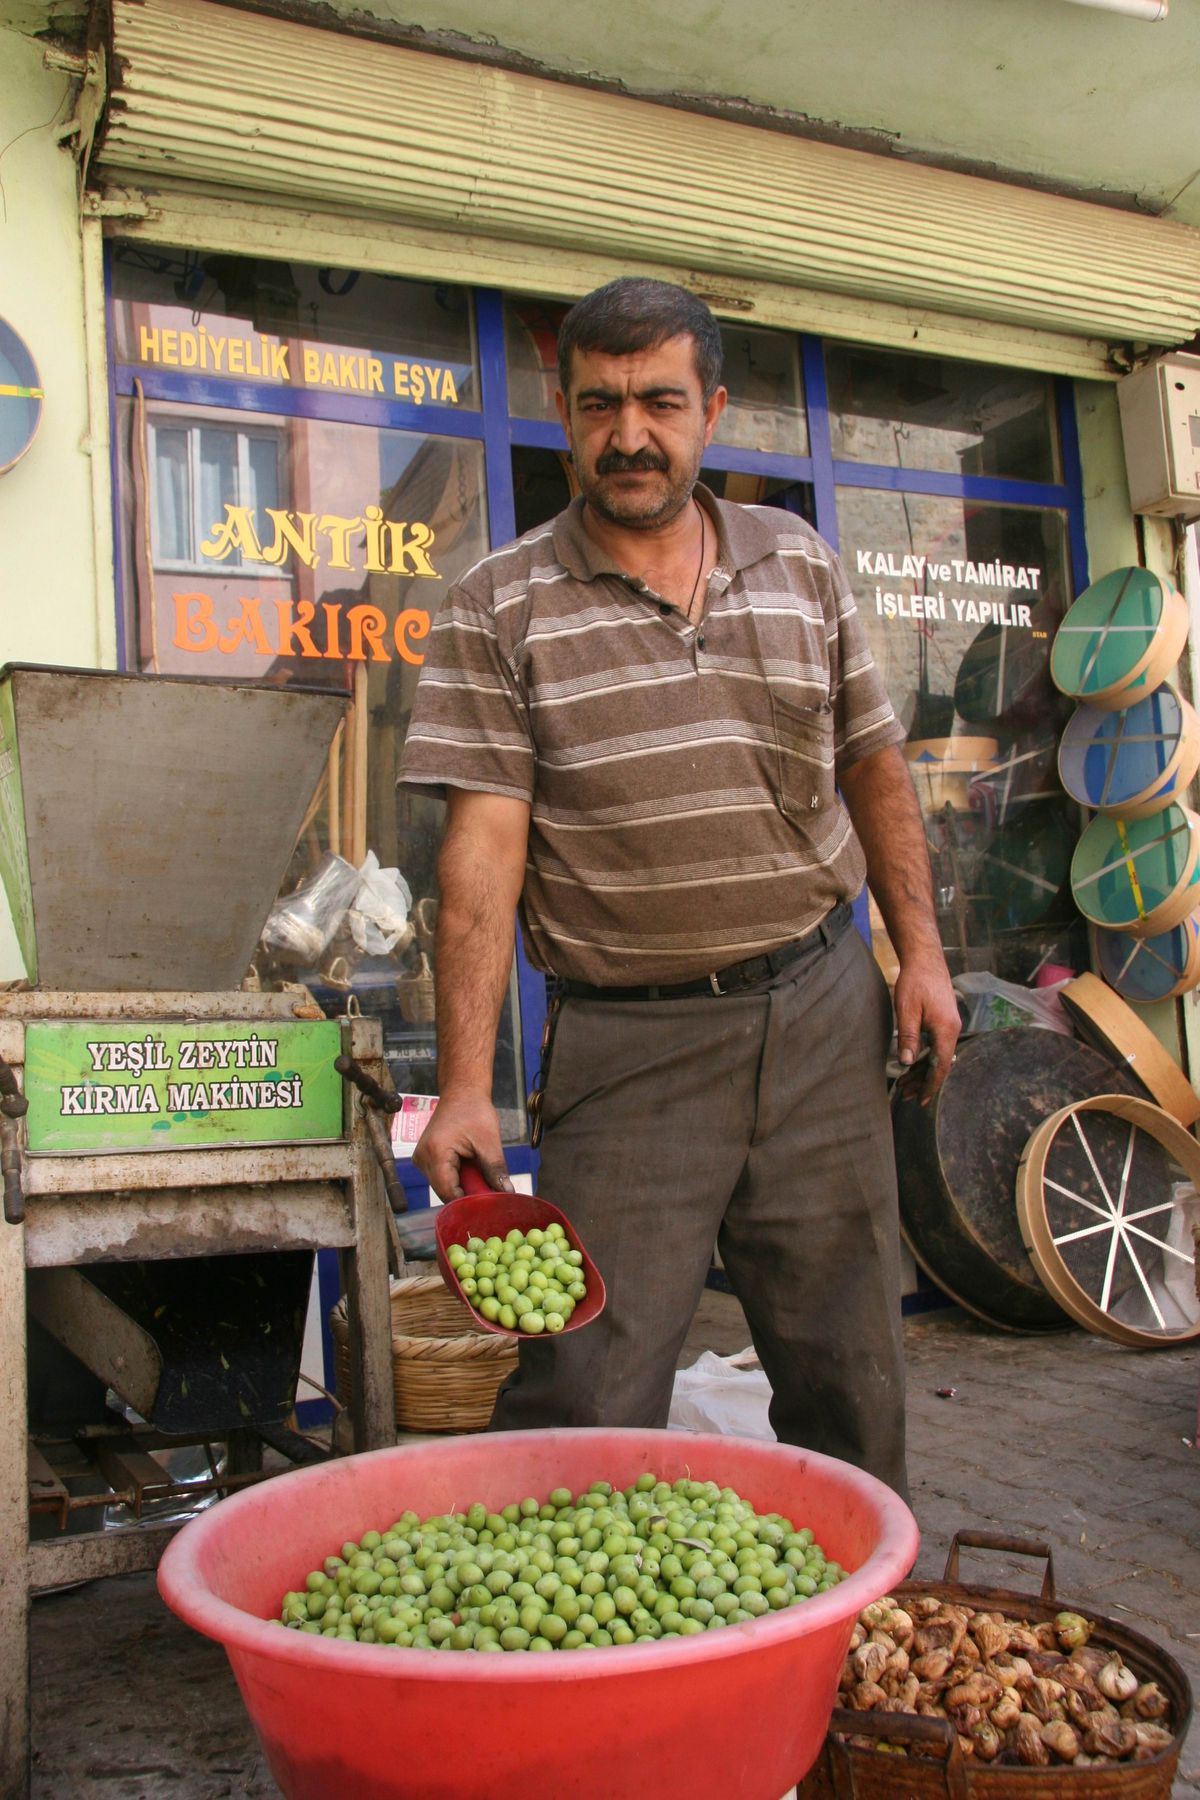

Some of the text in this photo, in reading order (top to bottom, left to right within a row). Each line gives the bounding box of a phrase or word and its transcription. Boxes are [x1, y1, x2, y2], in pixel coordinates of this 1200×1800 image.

[139, 325, 458, 405] HEDİYELİK BAKIR EŞYA
[200, 503, 442, 579] ANTİK
[857, 550, 1040, 590] KALAY ve TAMİRAT
[172, 592, 430, 665] BAKIRC
[876, 586, 1032, 627] İŞLERİ YAPILIR
[87, 1033, 278, 1077] YEŞİL ZEYTİN
[60, 1073, 303, 1115] KIRMA MAKİNESİ
